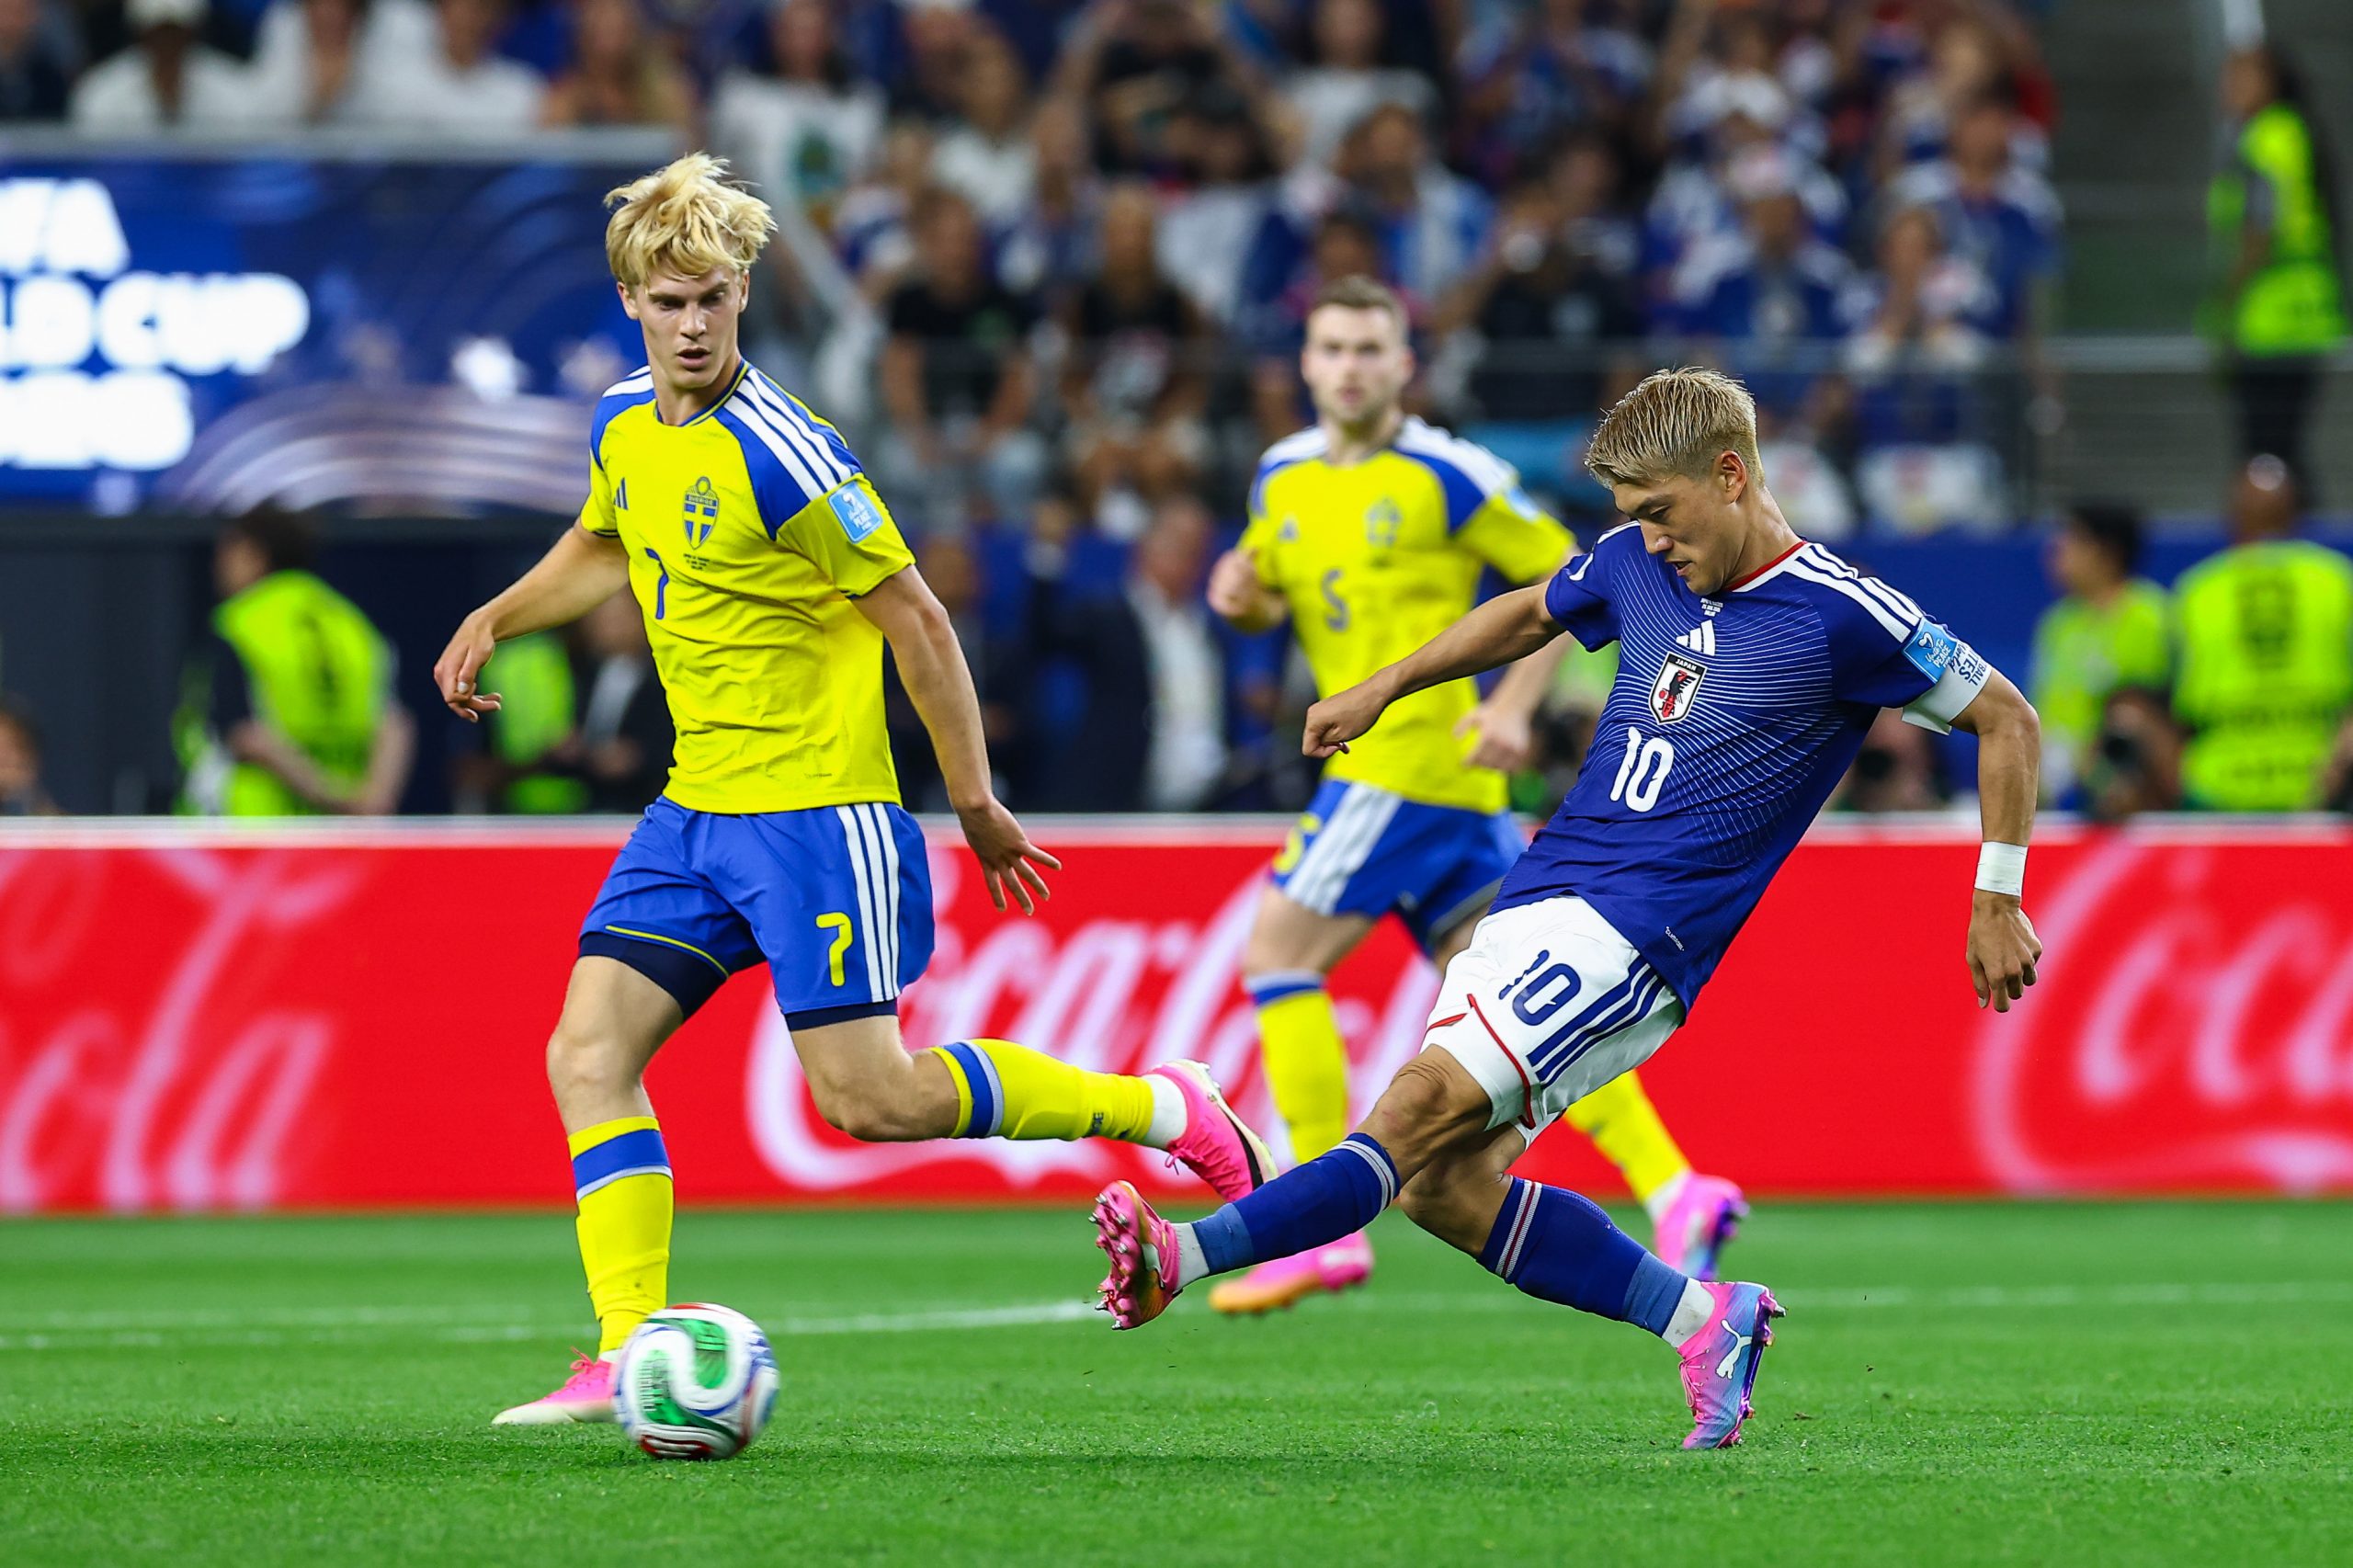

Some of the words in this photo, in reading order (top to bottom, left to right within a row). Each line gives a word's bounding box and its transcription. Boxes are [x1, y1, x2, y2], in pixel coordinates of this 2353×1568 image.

[644, 547, 669, 619] 7
[1675, 659, 1697, 671] JAPAN
[1933, 644, 1951, 668] PEACE
[1609, 726, 1675, 812] 10
[816, 912, 853, 987] 7
[1498, 949, 1581, 1026] 10
